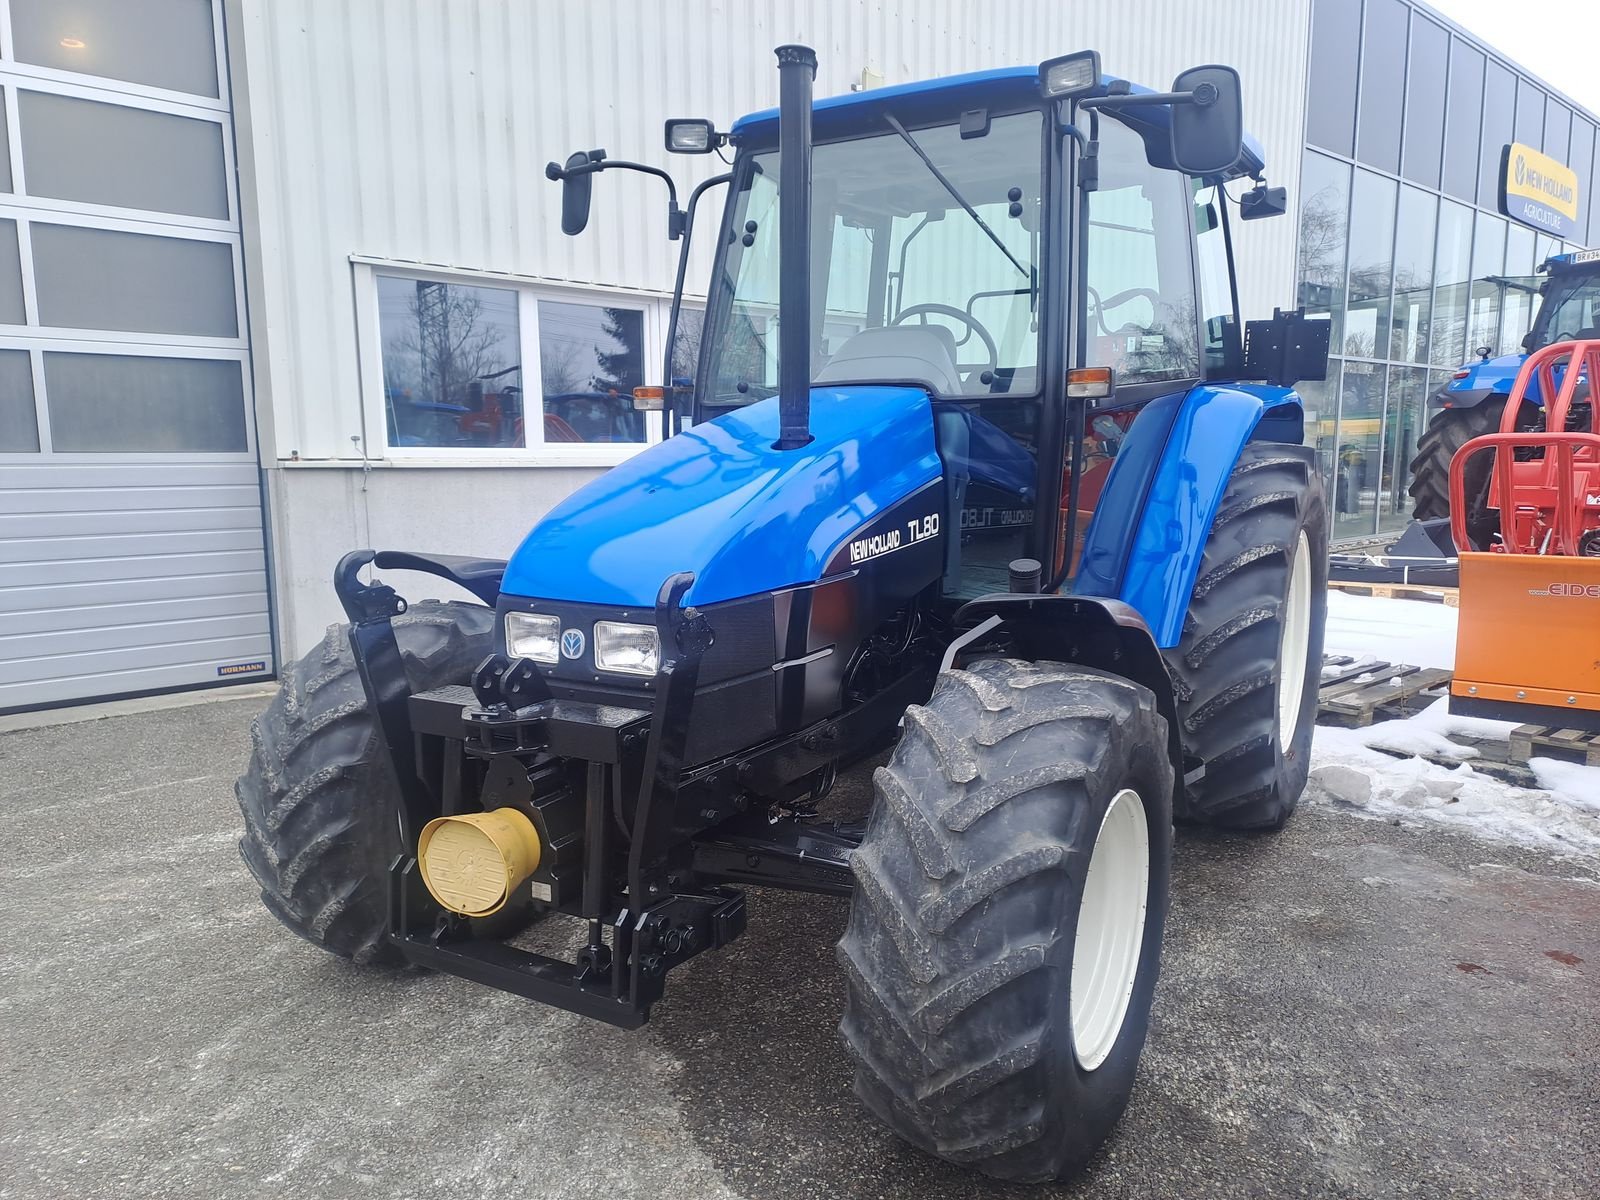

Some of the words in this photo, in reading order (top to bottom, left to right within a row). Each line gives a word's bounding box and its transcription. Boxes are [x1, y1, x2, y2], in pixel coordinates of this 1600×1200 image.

[1526, 167, 1542, 191] NEW
[1543, 175, 1573, 204] HOLLAND
[1523, 202, 1561, 230] AGRICULTURE
[850, 538, 868, 562] NEW
[868, 529, 900, 557] HOLLAND
[907, 513, 939, 542] TL80
